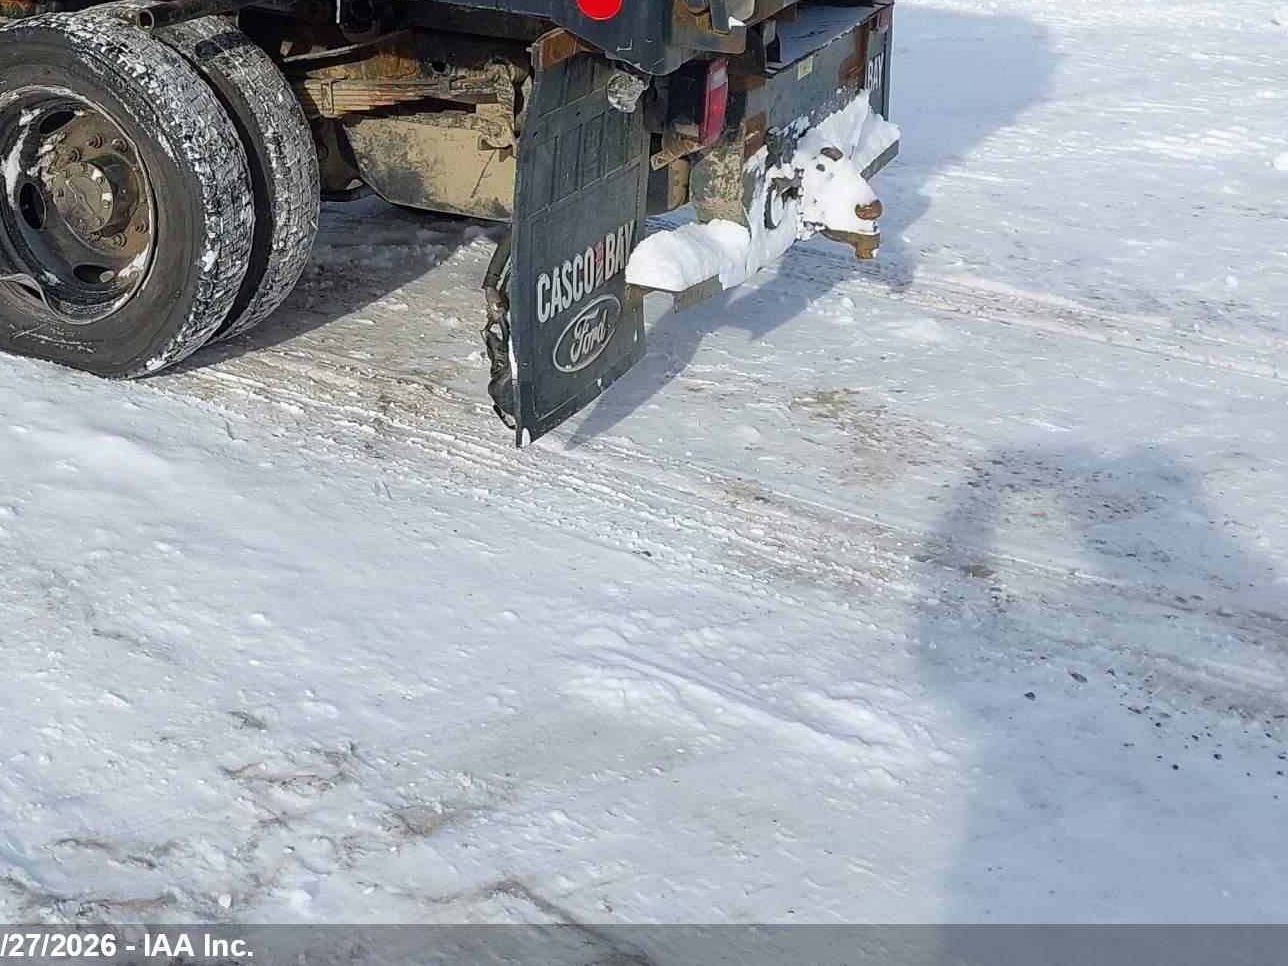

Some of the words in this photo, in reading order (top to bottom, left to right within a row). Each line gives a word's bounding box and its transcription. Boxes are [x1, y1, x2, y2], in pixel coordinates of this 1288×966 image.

[537, 244, 595, 324] CASCO
[604, 218, 635, 281] BAY
[569, 305, 608, 364] Ford
